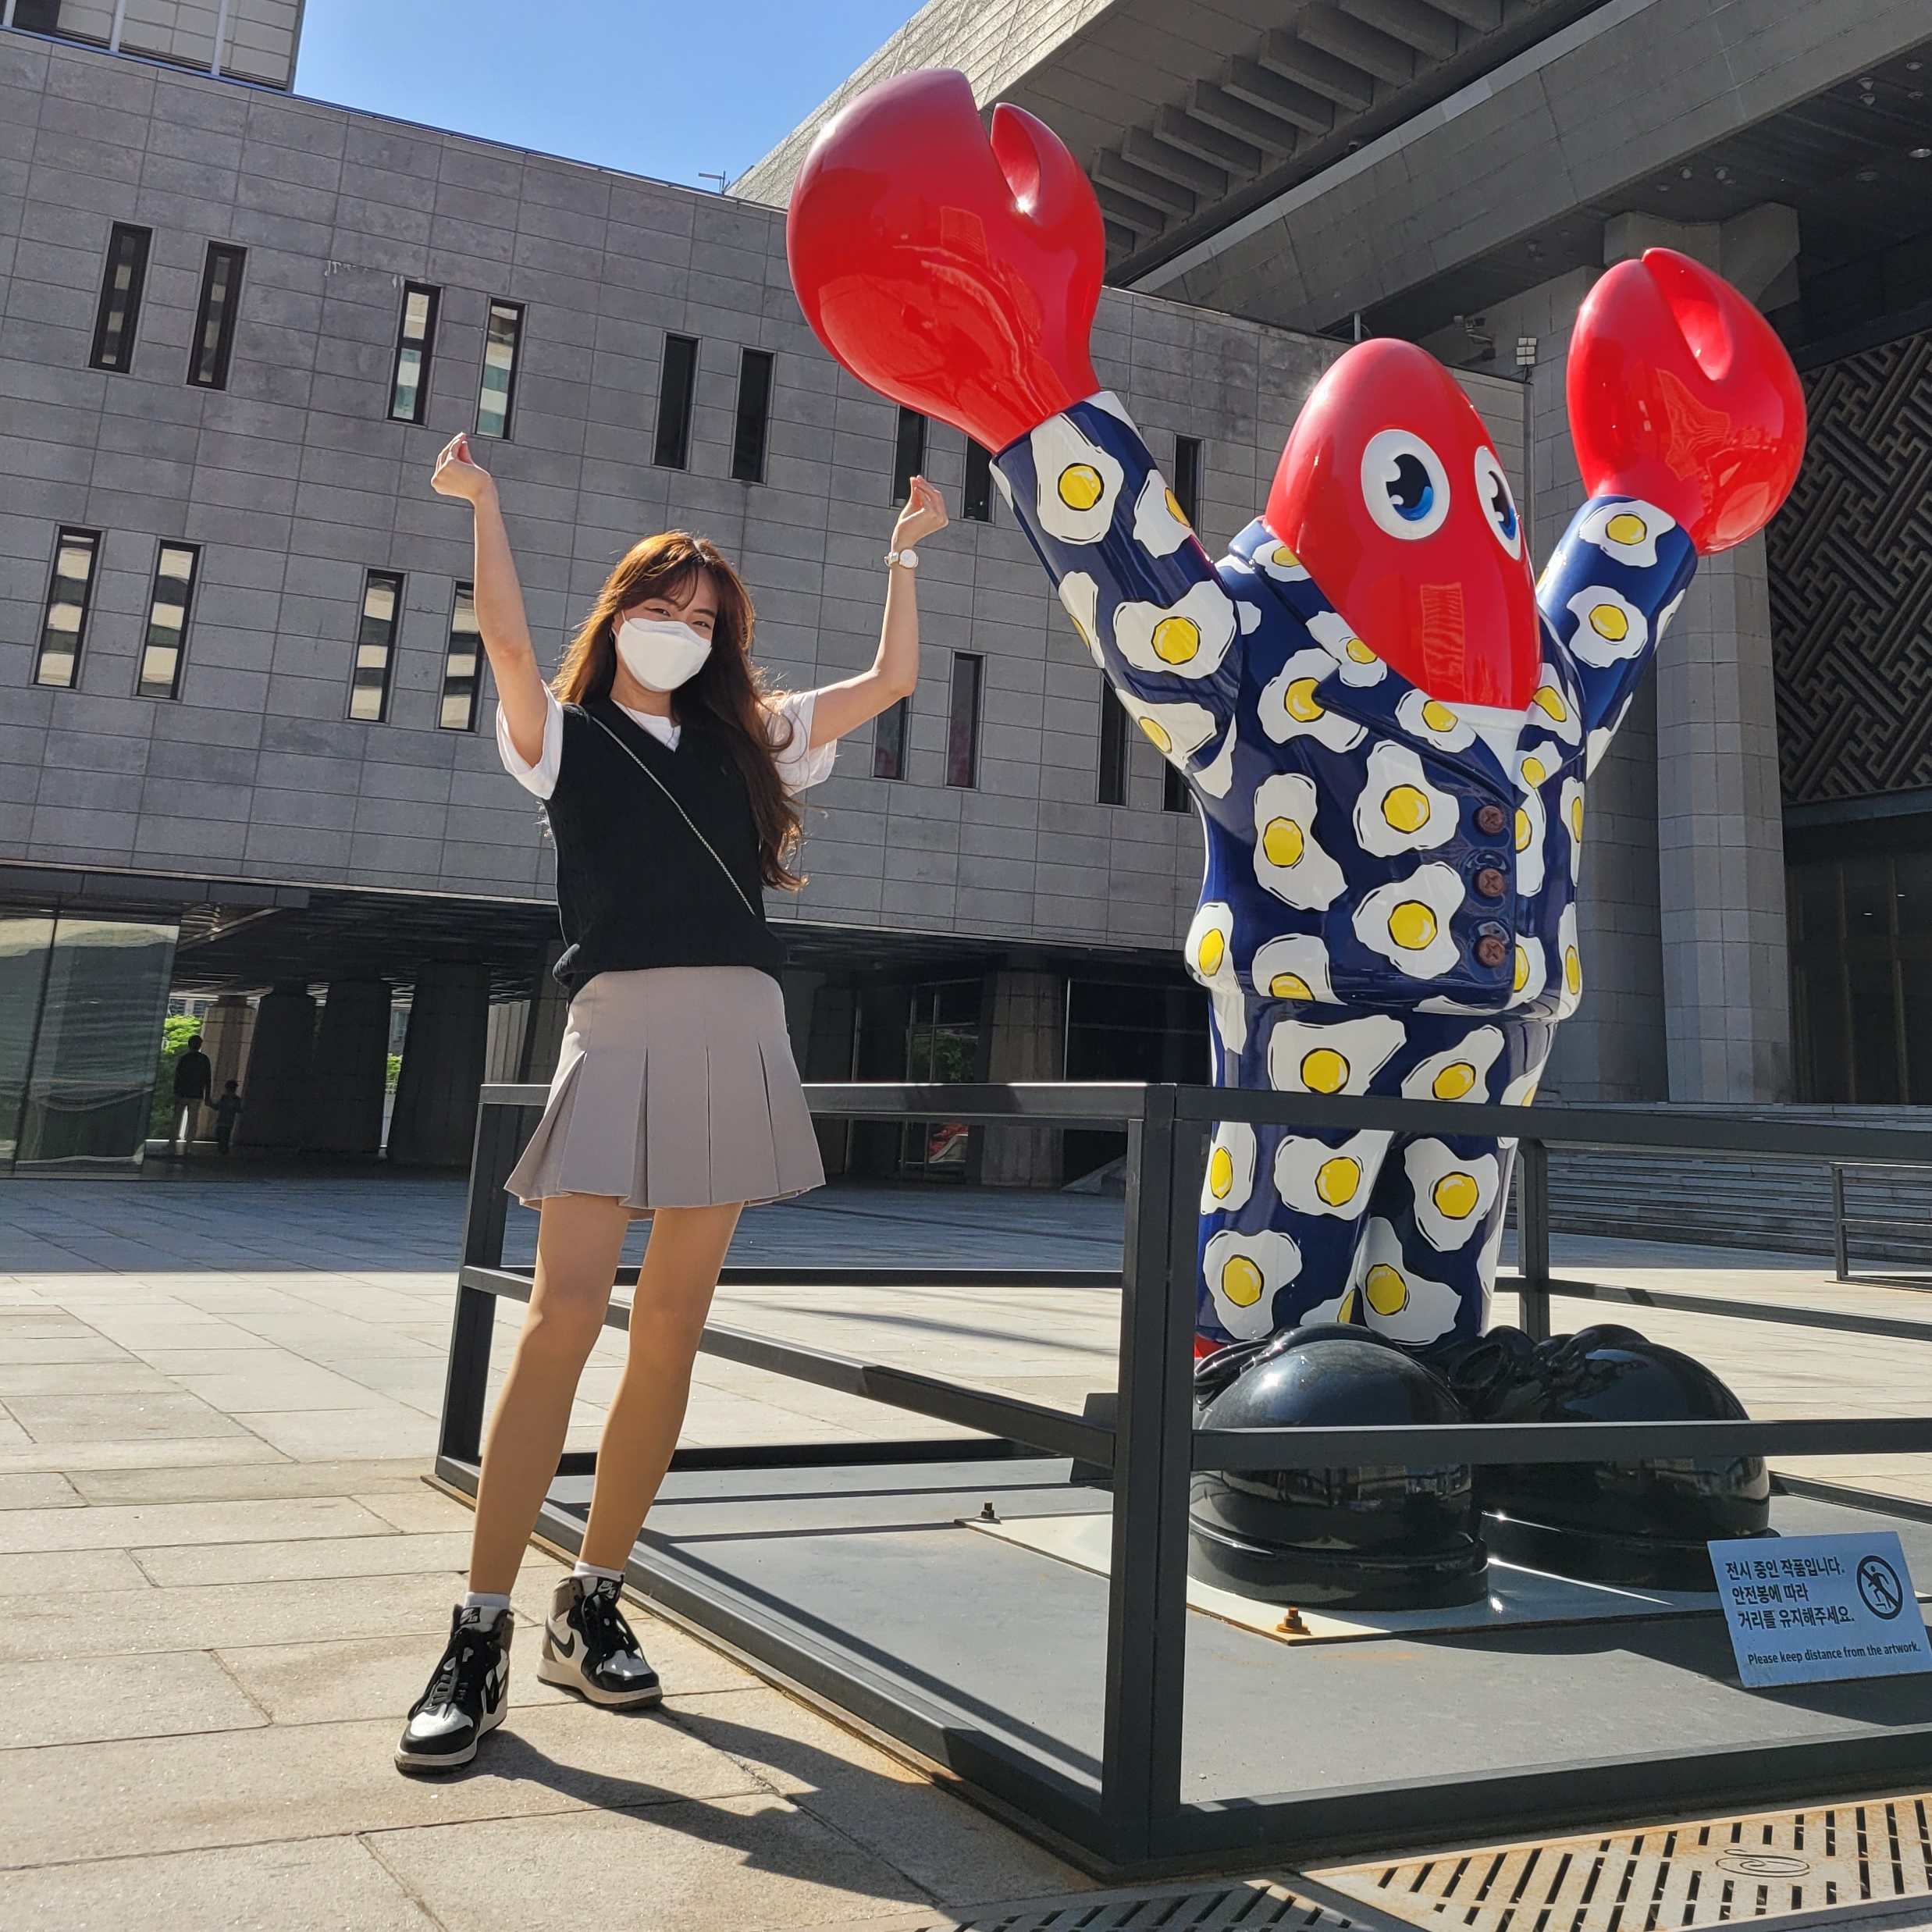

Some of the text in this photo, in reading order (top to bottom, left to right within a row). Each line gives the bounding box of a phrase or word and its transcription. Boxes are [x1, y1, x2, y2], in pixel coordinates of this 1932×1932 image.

[1725, 1557, 1845, 1581] 전시 중인 작품입니다.
[1732, 1582, 1809, 1605] 안전봉에 따라
[1738, 1606, 1855, 1630] 거리를 유지해주세요.
[1748, 1641, 1921, 1665] Please keep distance from the artwork.
